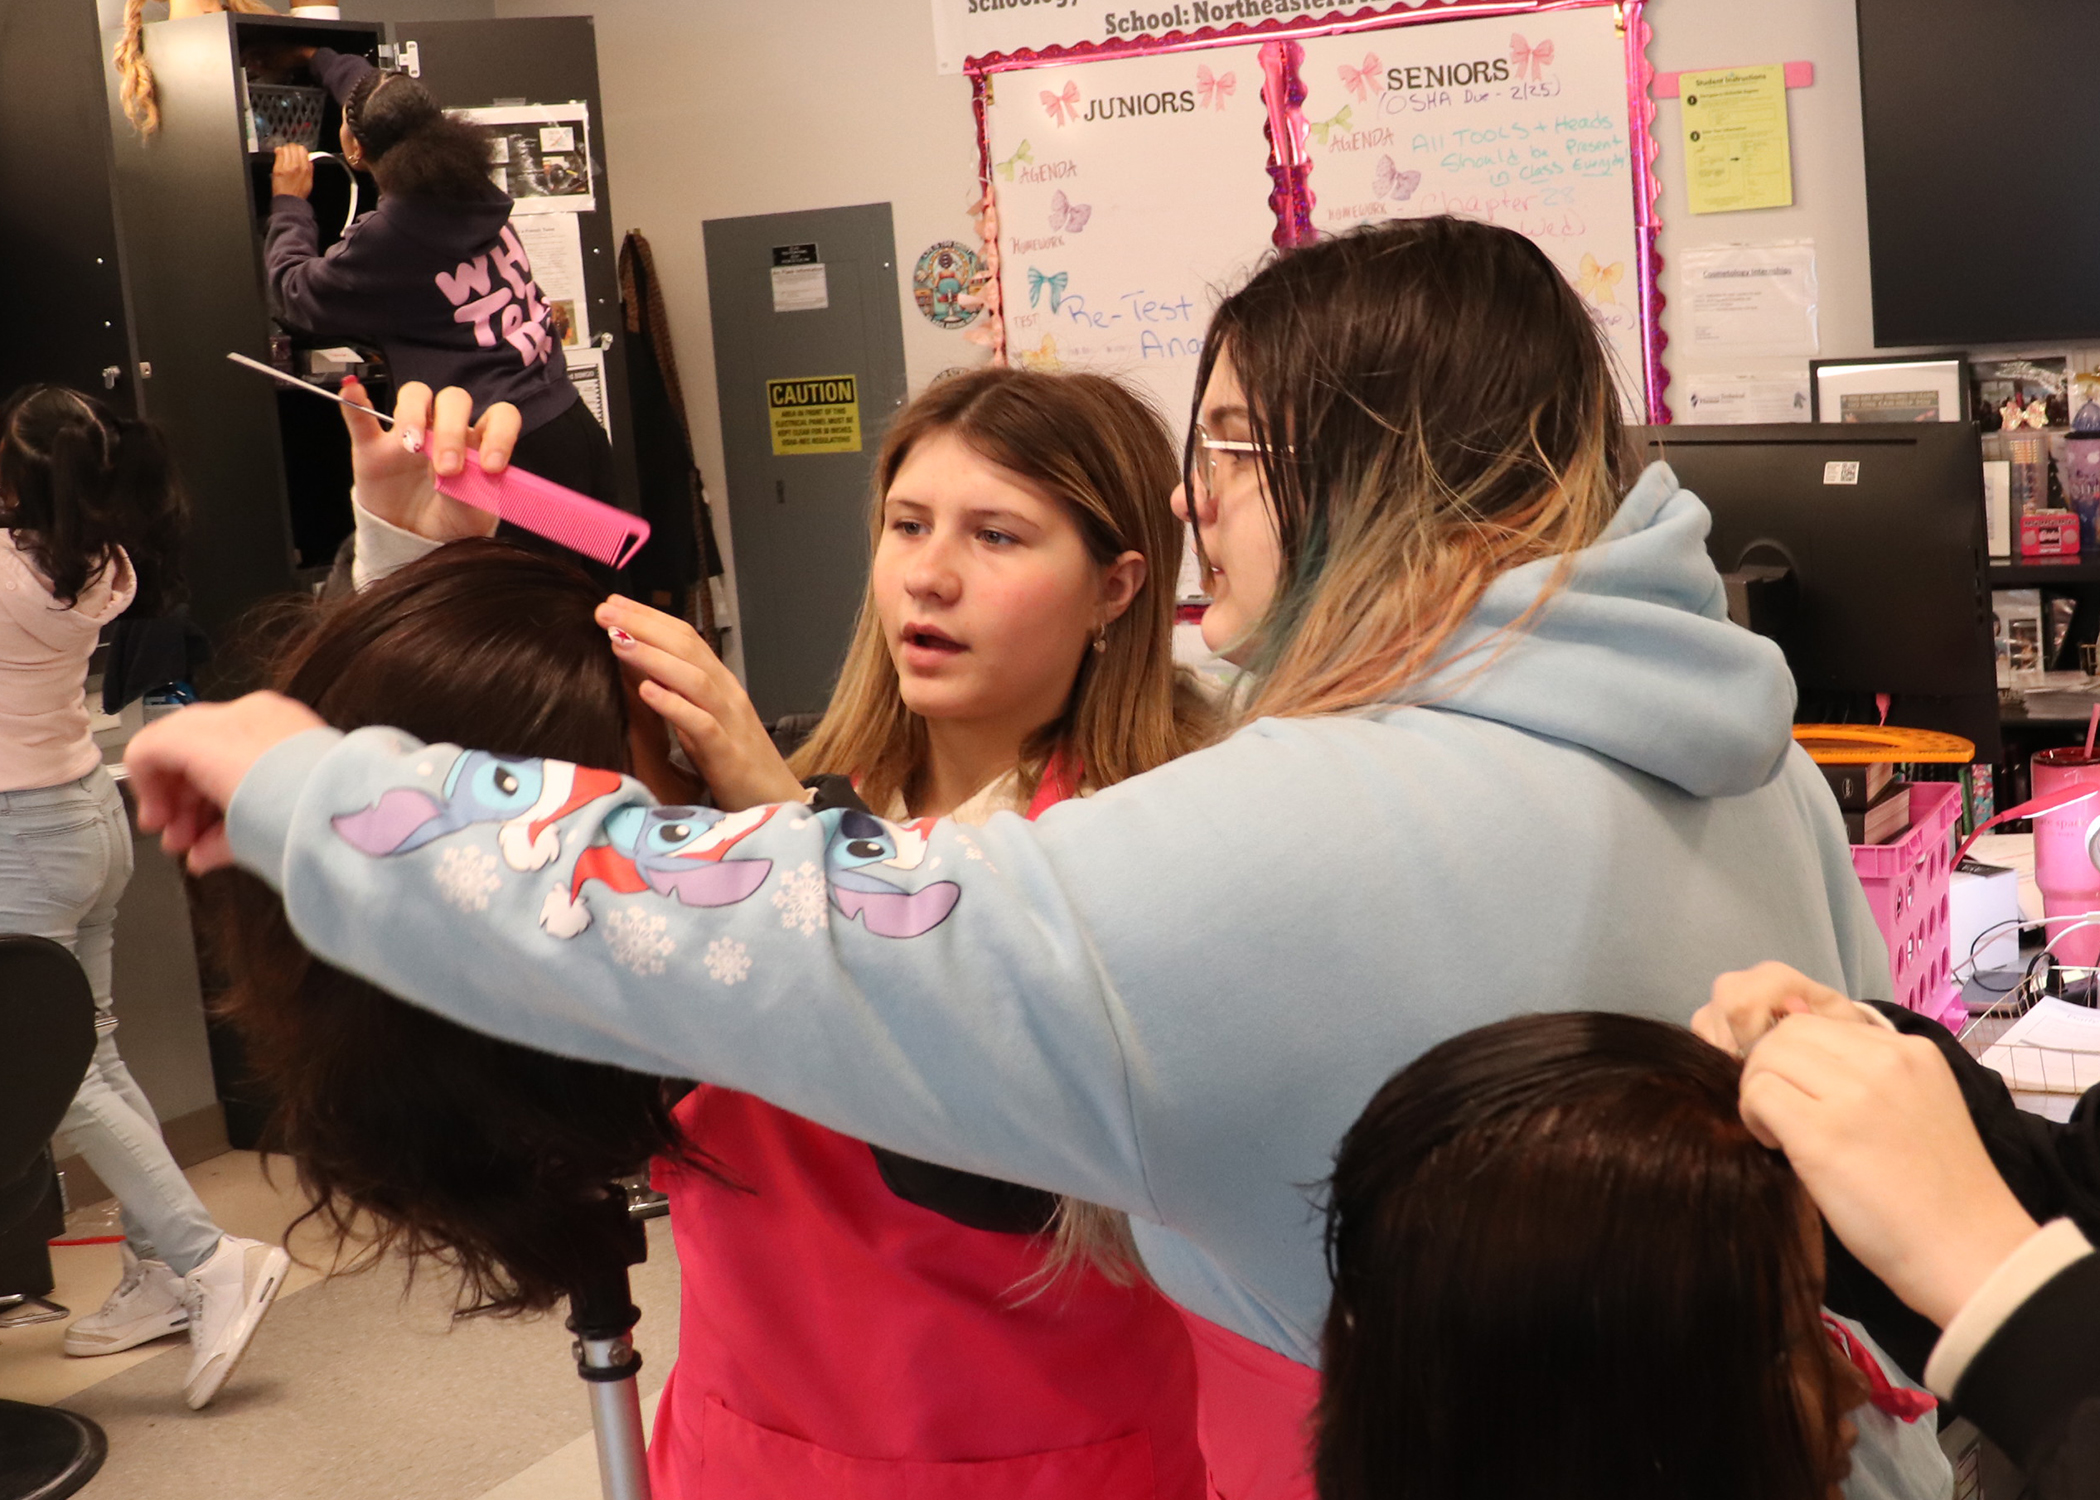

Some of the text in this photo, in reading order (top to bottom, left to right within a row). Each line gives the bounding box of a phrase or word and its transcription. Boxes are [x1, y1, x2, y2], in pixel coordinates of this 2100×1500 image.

[968, 0, 1079, 13] Schoo
[1105, 5, 1190, 35] School:
[1387, 58, 1509, 91] SENIORS
[1696, 78, 1723, 86] Student
[1084, 91, 1195, 121] JUNIORS
[1376, 91, 1451, 119] (OSHA
[1555, 115, 1614, 134] Heads
[1329, 127, 1394, 153] AGENDA
[1565, 136, 1624, 155] Present
[1019, 160, 1077, 184] AGENDA
[1519, 162, 1564, 181] Class
[1328, 202, 1388, 220] HOMEWORK
[1420, 191, 1539, 221] Chapter
[1011, 235, 1065, 254] HOMEWORK
[1013, 313, 1039, 328] TEST
[1058, 290, 1194, 328] Re-Test
[772, 382, 852, 405] CAUTION
